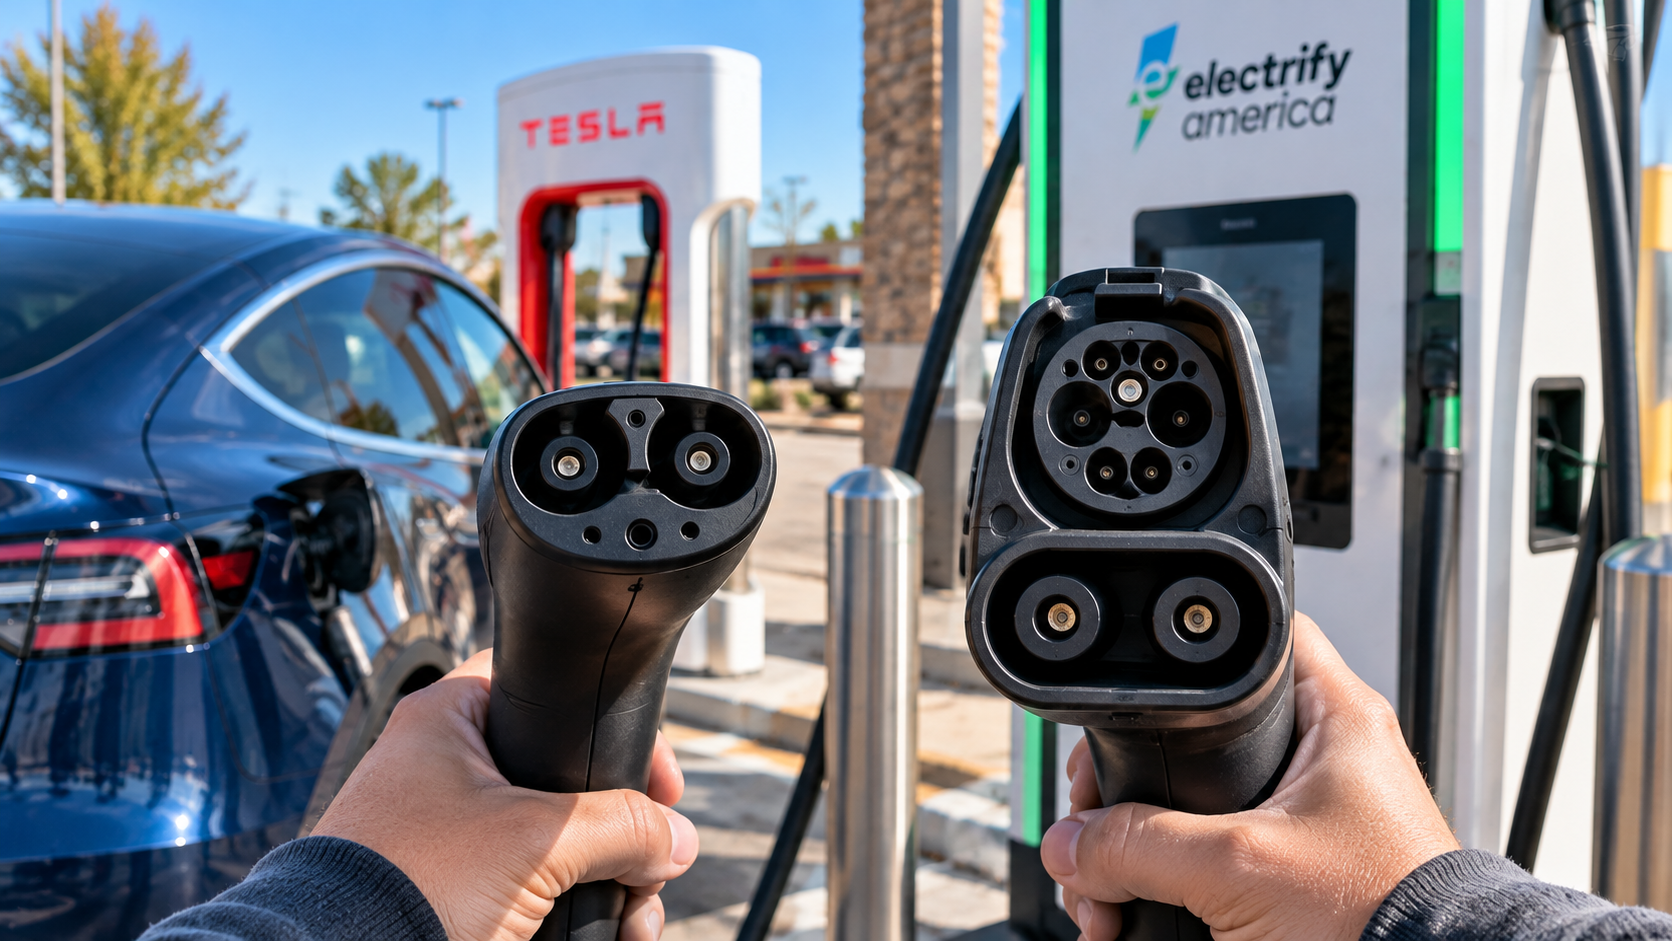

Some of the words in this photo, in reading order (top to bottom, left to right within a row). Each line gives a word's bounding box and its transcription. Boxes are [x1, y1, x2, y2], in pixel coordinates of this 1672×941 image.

[1184, 41, 1352, 100] electrify
[519, 101, 665, 148] TESLA
[1181, 91, 1336, 141] america
